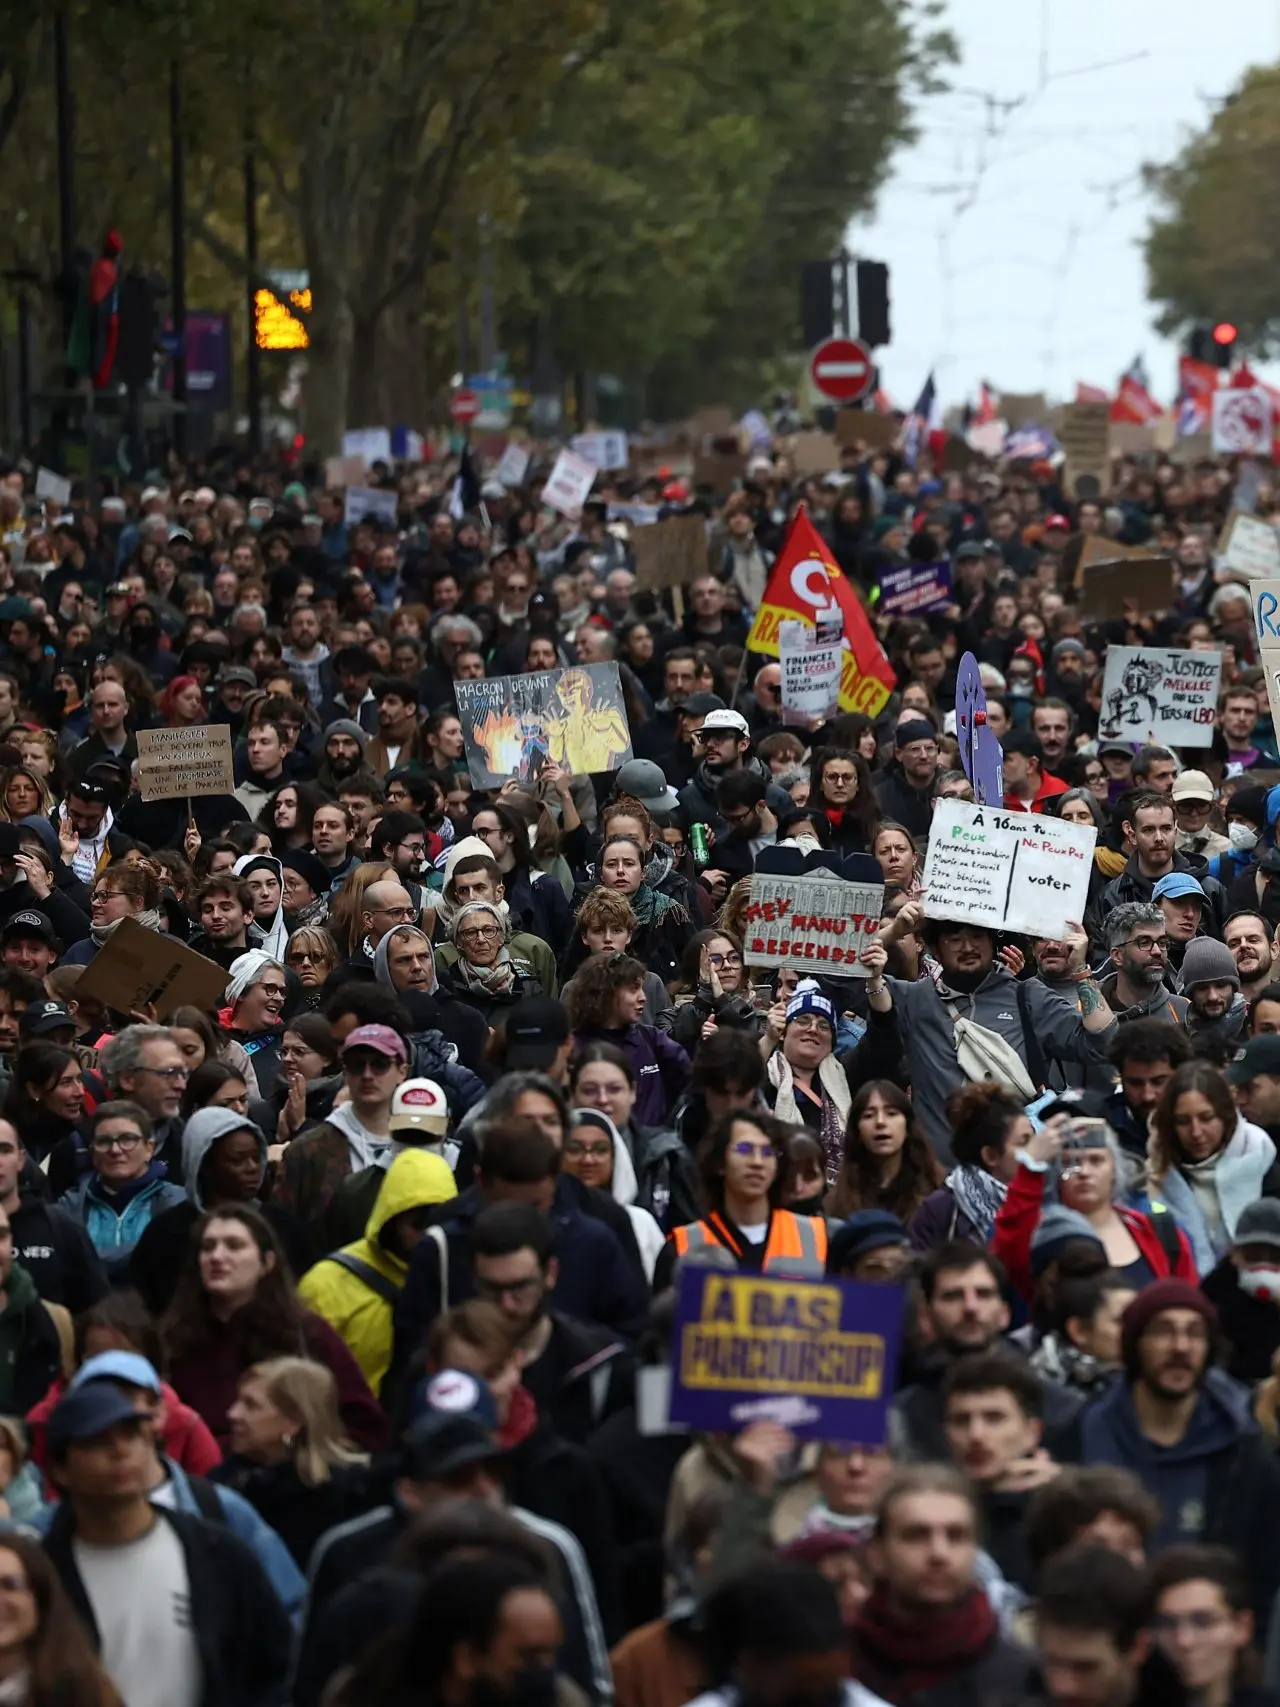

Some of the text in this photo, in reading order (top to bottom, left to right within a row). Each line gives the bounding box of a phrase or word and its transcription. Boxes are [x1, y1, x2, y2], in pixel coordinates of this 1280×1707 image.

[1166, 654, 1219, 677] JUSTICE
[456, 676, 550, 699] MACRON DEVANT
[1188, 694, 1204, 704] LES
[151, 728, 208, 743] MANIFESTER
[951, 825, 987, 843] Peux
[1022, 837, 1039, 850] Ne
[1027, 874, 1072, 892] voter
[746, 897, 793, 924] HEY
[791, 914, 879, 935] MANU TU
